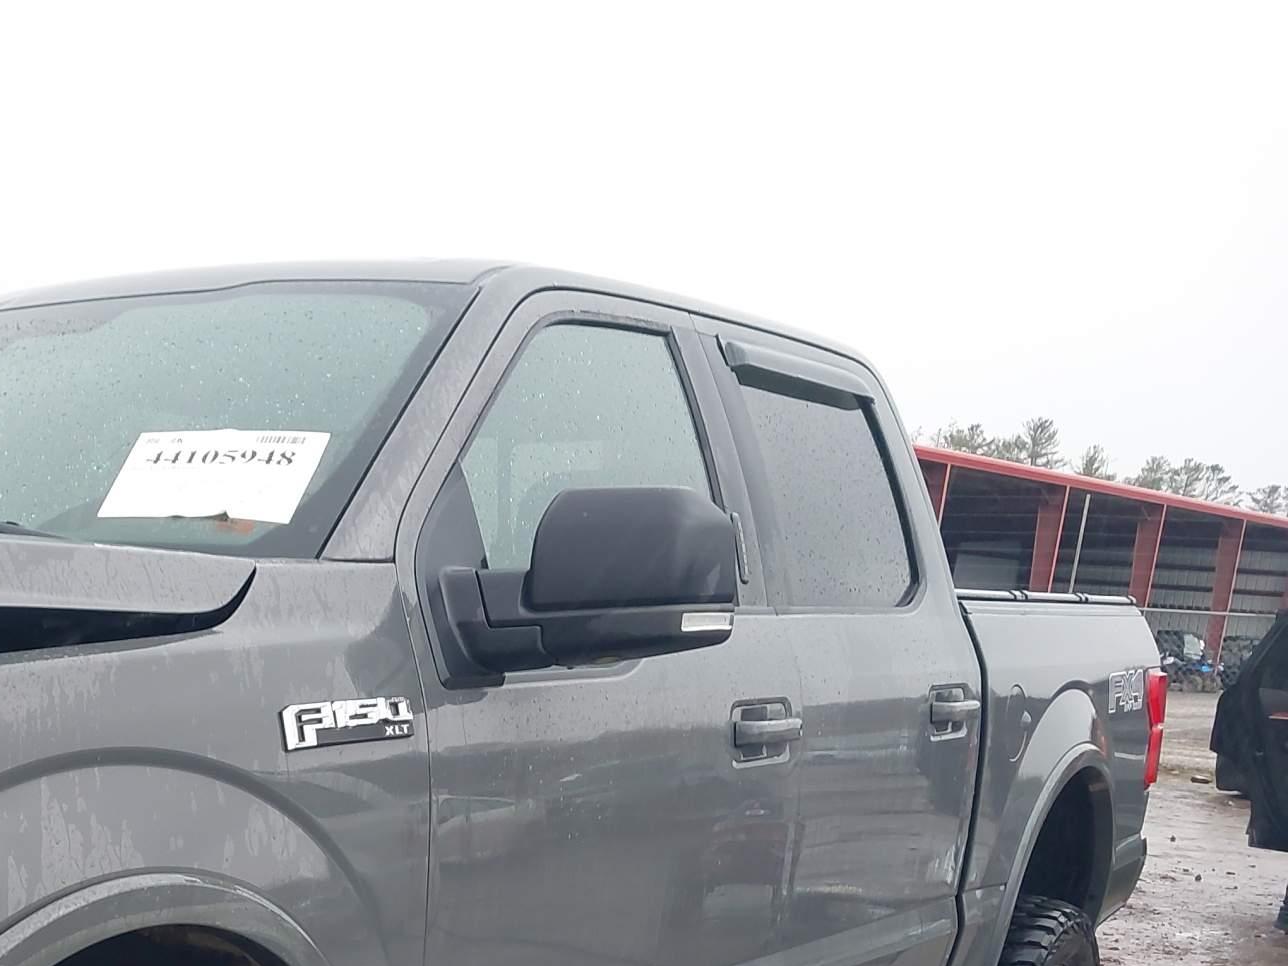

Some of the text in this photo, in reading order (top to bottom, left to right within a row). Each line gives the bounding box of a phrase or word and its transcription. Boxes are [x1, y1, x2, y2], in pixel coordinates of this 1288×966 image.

[145, 450, 296, 466] 44105948
[1108, 668, 1144, 714] FX4
[384, 723, 410, 736] XLT
